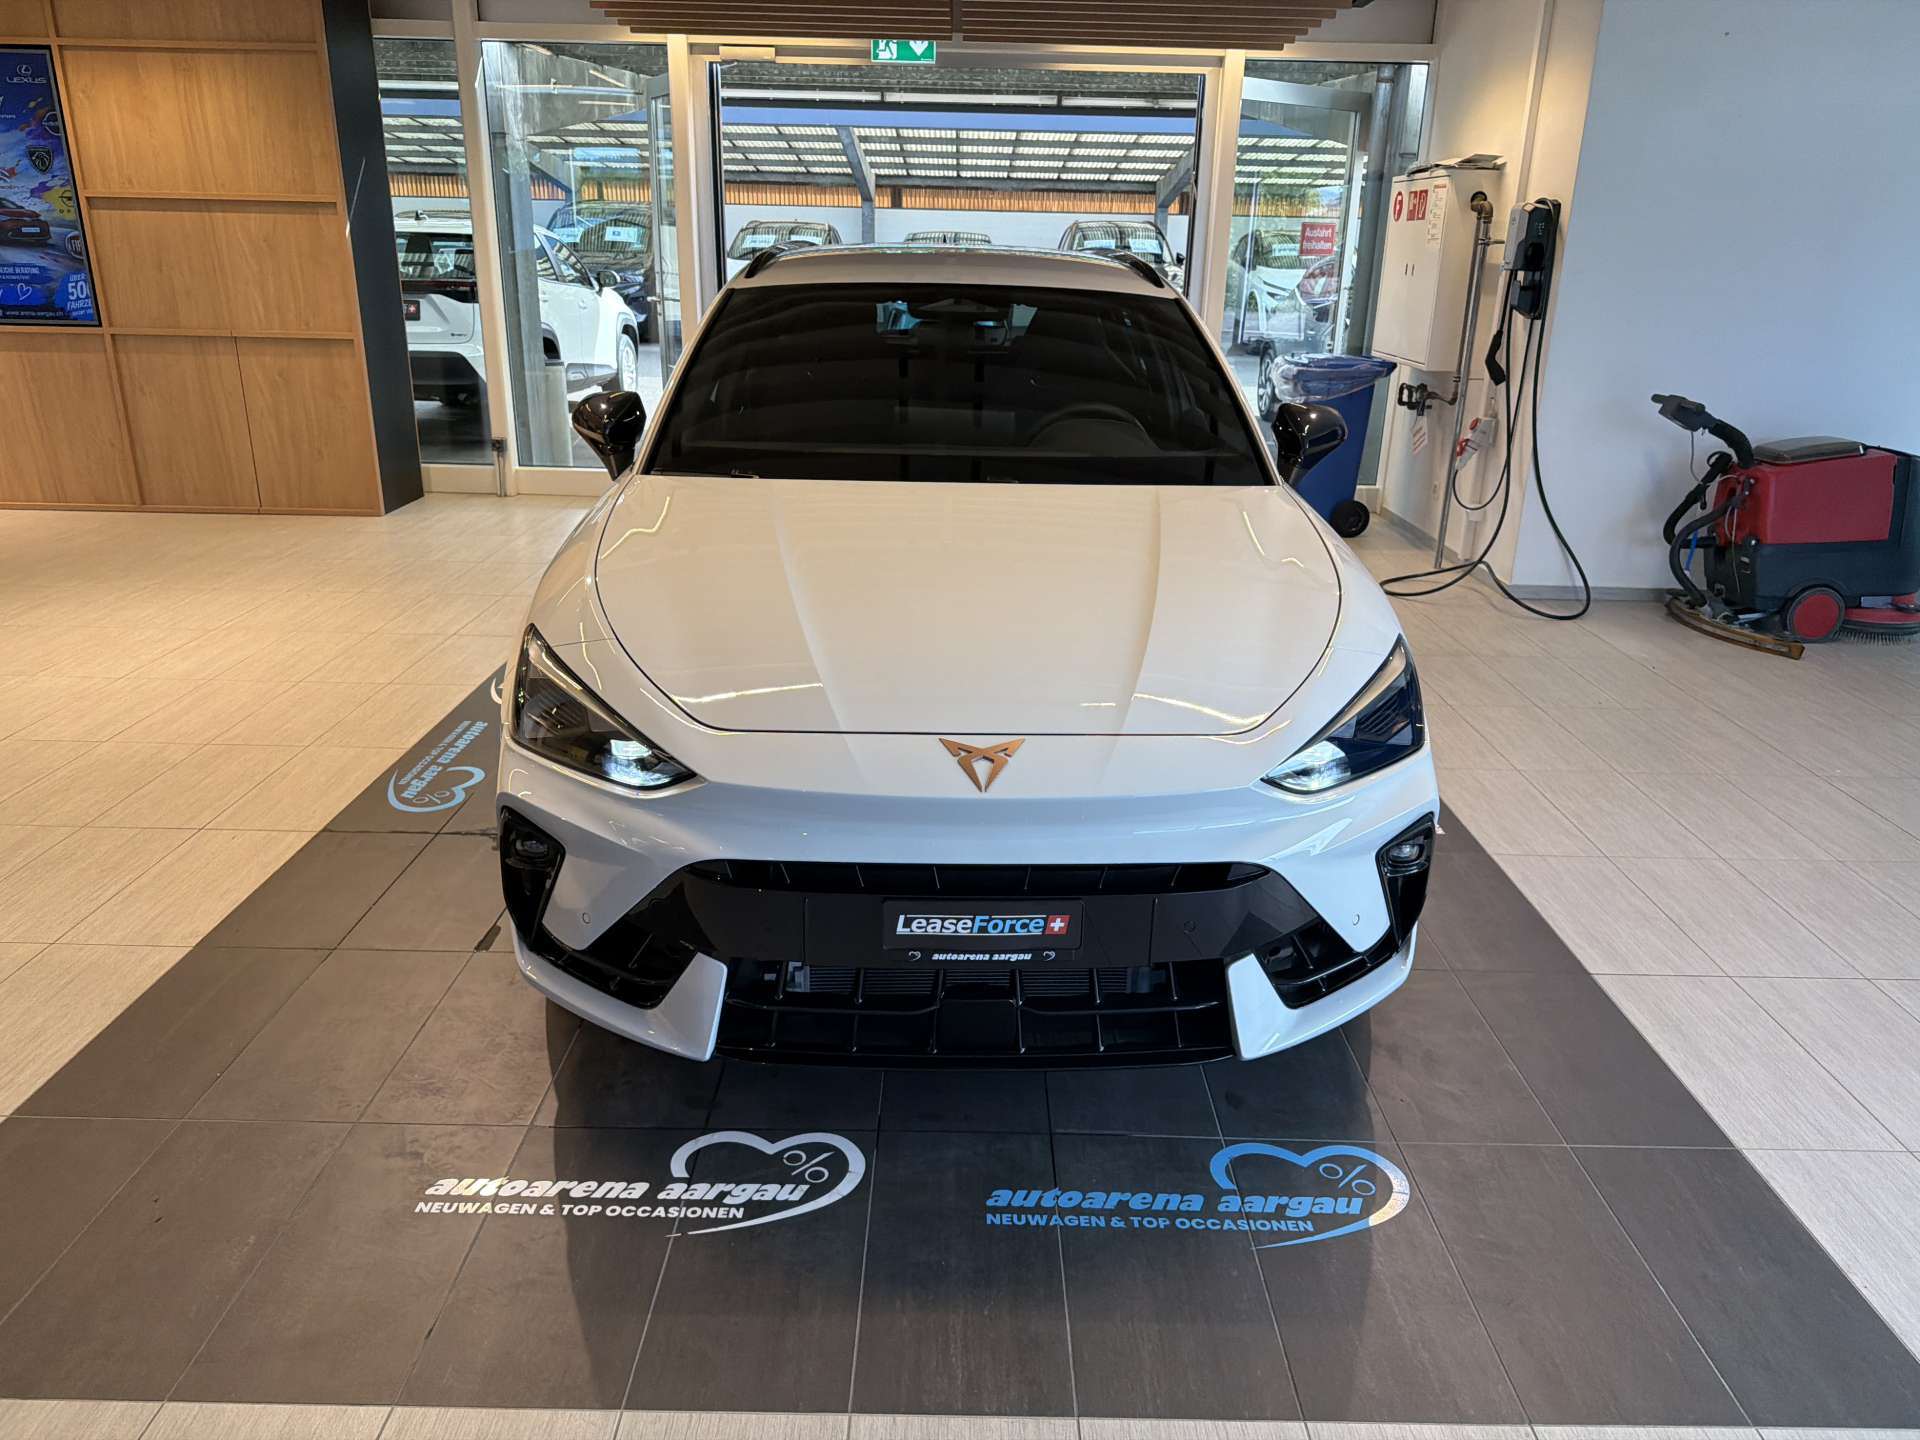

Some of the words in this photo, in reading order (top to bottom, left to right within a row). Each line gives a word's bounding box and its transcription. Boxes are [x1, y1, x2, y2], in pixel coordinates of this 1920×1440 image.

[896, 914, 1045, 935] LeaseForce
[931, 952, 990, 961] autoarena
[991, 952, 1033, 962] aargau
[424, 1176, 651, 1199] autoarena
[656, 1181, 811, 1202] aargau
[414, 1201, 537, 1216] NEUWAGEN
[539, 1203, 556, 1217] &
[561, 1204, 602, 1217] TOP
[605, 1205, 745, 1220] OCCASIONEN
[985, 1187, 1205, 1213] autoarena
[1216, 1192, 1365, 1217] aargau
[985, 1213, 1106, 1229] NEUWAGEN
[1109, 1217, 1127, 1230] &
[1129, 1216, 1171, 1231] TOP
[1177, 1218, 1315, 1233] OCCASIONEN
